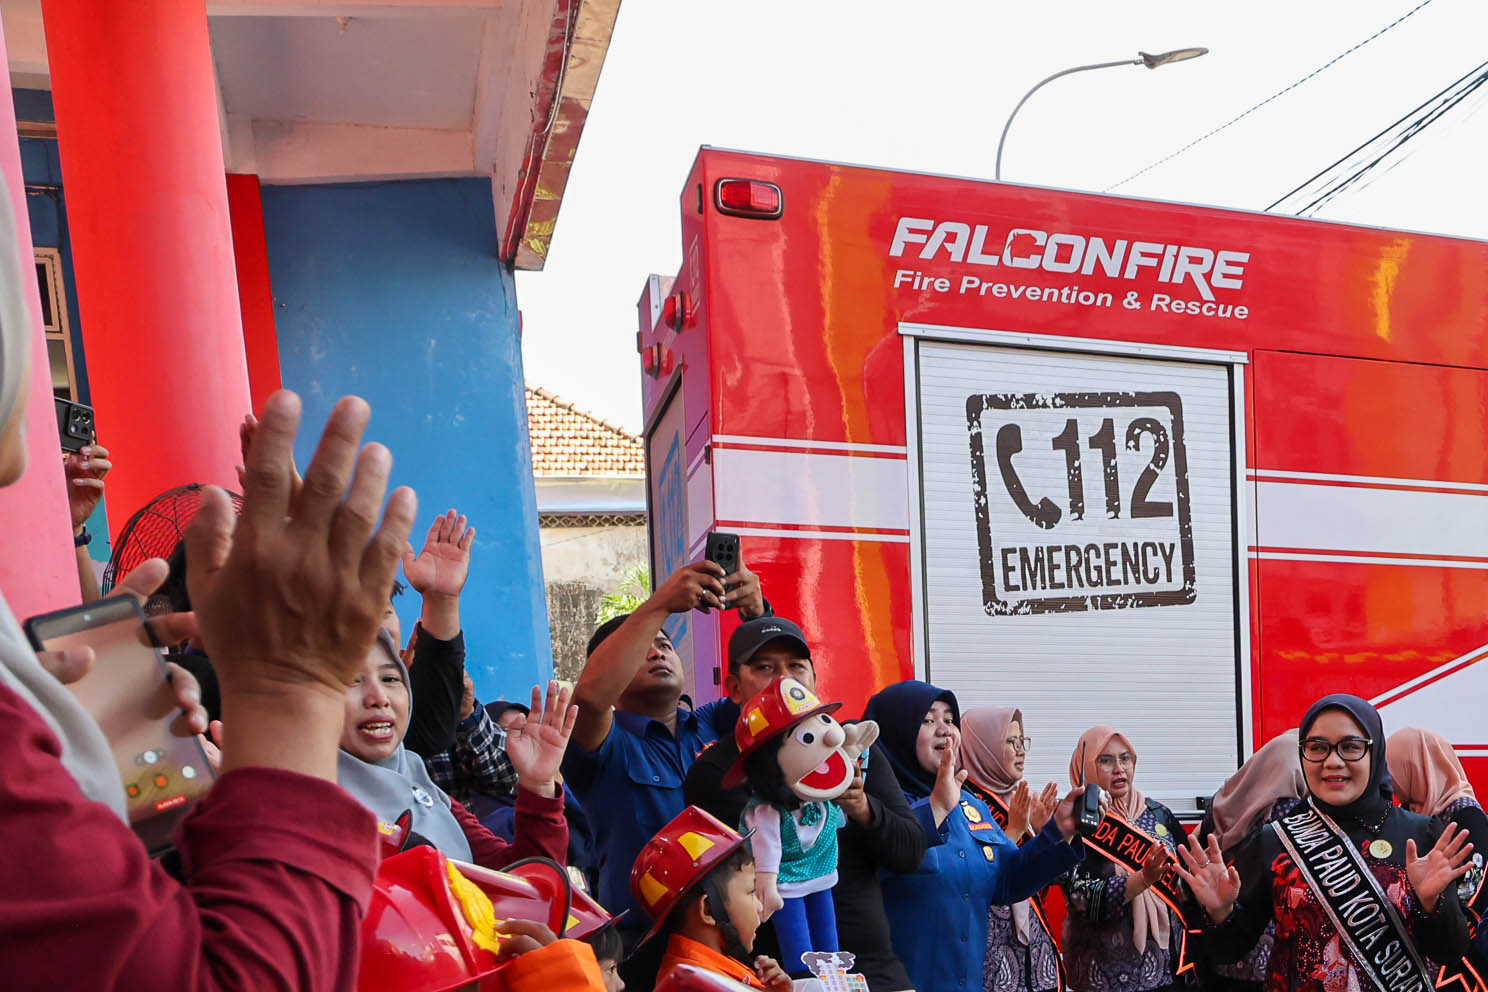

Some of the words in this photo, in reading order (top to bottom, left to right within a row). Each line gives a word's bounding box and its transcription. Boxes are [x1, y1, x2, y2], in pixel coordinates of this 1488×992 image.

[889, 217, 1250, 300] FALCONFIRE
[893, 270, 951, 293] Fire
[960, 276, 1113, 307] Prevention
[1122, 291, 1142, 309] &
[1150, 293, 1249, 320] Rescue
[1052, 417, 1174, 521] 112
[1000, 541, 1176, 592] EMERGENCY
[1283, 810, 1334, 861] BUNDA
[1314, 844, 1362, 897] PAUD
[1338, 890, 1390, 950] KOTA
